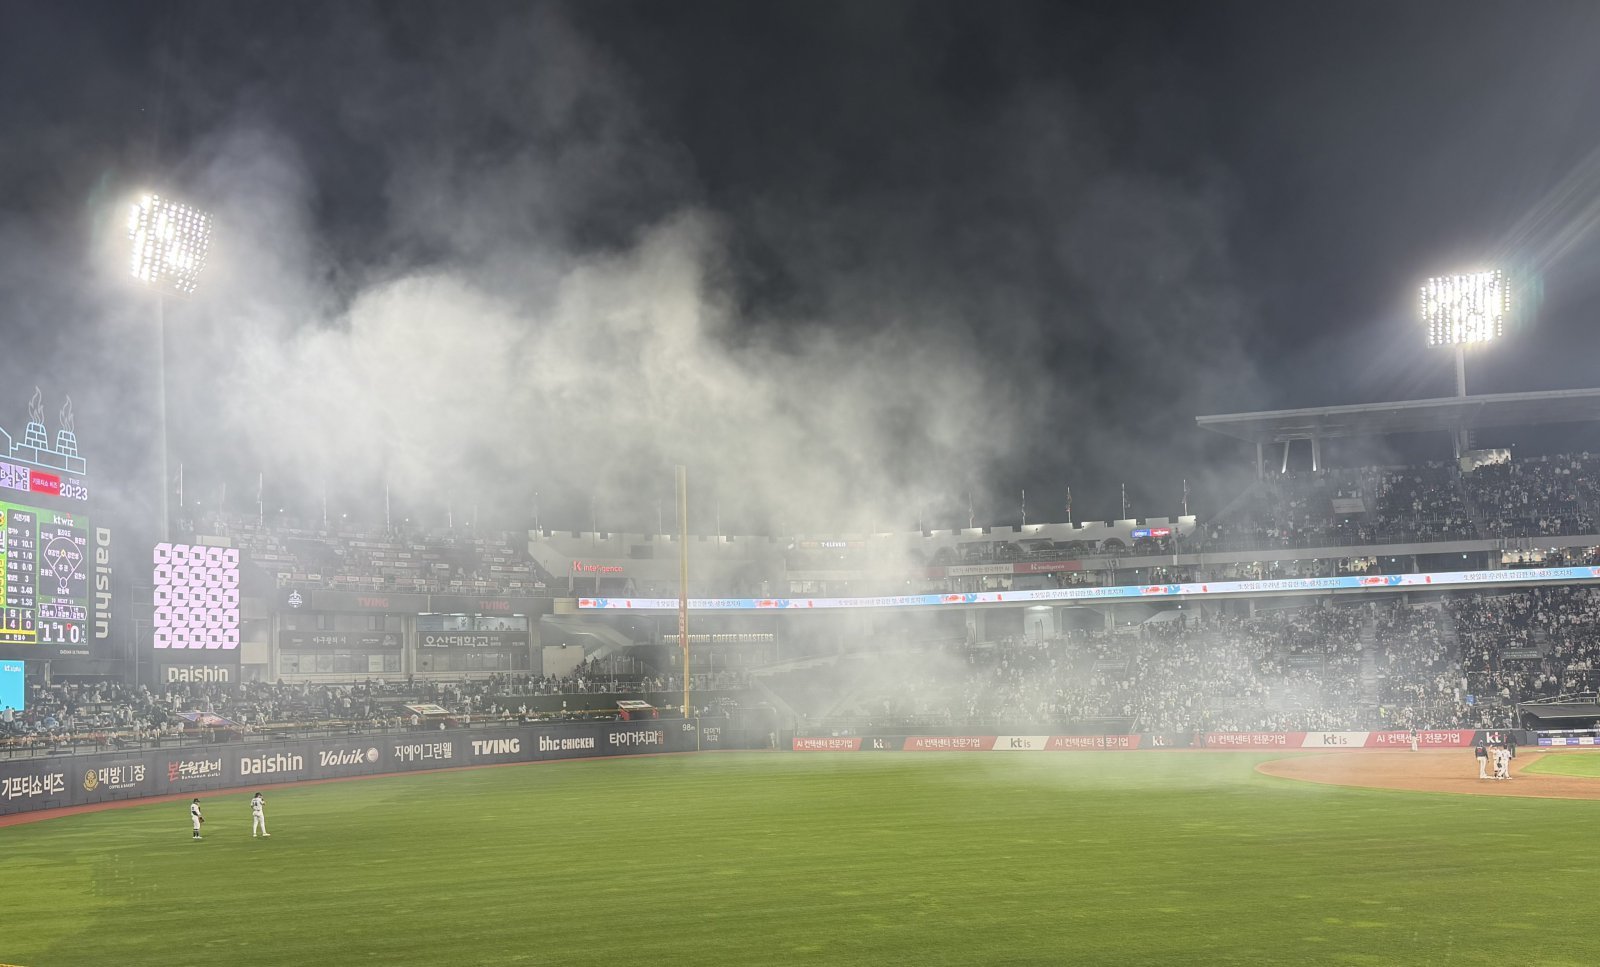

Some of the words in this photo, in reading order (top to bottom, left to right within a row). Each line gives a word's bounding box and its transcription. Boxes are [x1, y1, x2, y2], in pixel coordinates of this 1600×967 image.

[22, 469, 27, 479] 5
[8, 477, 13, 487] 3
[22, 480, 27, 490] 6
[60, 483, 88, 500] 20:23
[573, 560, 582, 571] K
[96, 527, 111, 639] Daishin
[358, 597, 389, 608] TVING
[480, 600, 509, 610] TVING
[43, 624, 51, 641] 1
[57, 625, 65, 642] 1
[71, 626, 79, 643] 0
[424, 636, 488, 647] 오산대학교
[688, 634, 710, 643] YOUNG
[713, 634, 736, 643] COFFEE
[739, 634, 774, 642] ROASTERS
[168, 665, 229, 682] Daishin
[609, 730, 658, 746] 타이거치과
[925, 739, 951, 748] 컨택센터
[952, 738, 980, 748] 전문기업
[1010, 738, 1021, 748] kt
[1065, 738, 1094, 747] 컨택센터
[1096, 737, 1129, 747] 전문기업
[1152, 736, 1164, 746] kt
[1218, 734, 1250, 744] 컨택센터
[1253, 734, 1286, 744] 전문기업
[1323, 734, 1336, 744] kt
[1339, 736, 1347, 744] is
[1376, 734, 1386, 743] AI
[1425, 733, 1460, 744] 전문기업
[1486, 732, 1501, 743] kt
[471, 738, 520, 755] TVING
[539, 736, 560, 751] bhc
[562, 737, 594, 750] CHICKEN
[873, 739, 884, 748] kt
[319, 748, 365, 766] Volvik
[394, 742, 452, 762] 지에이그린웰
[240, 752, 303, 775] Daishin
[2, 774, 42, 800] 기프티쇼
[44, 773, 64, 795] 비즈
